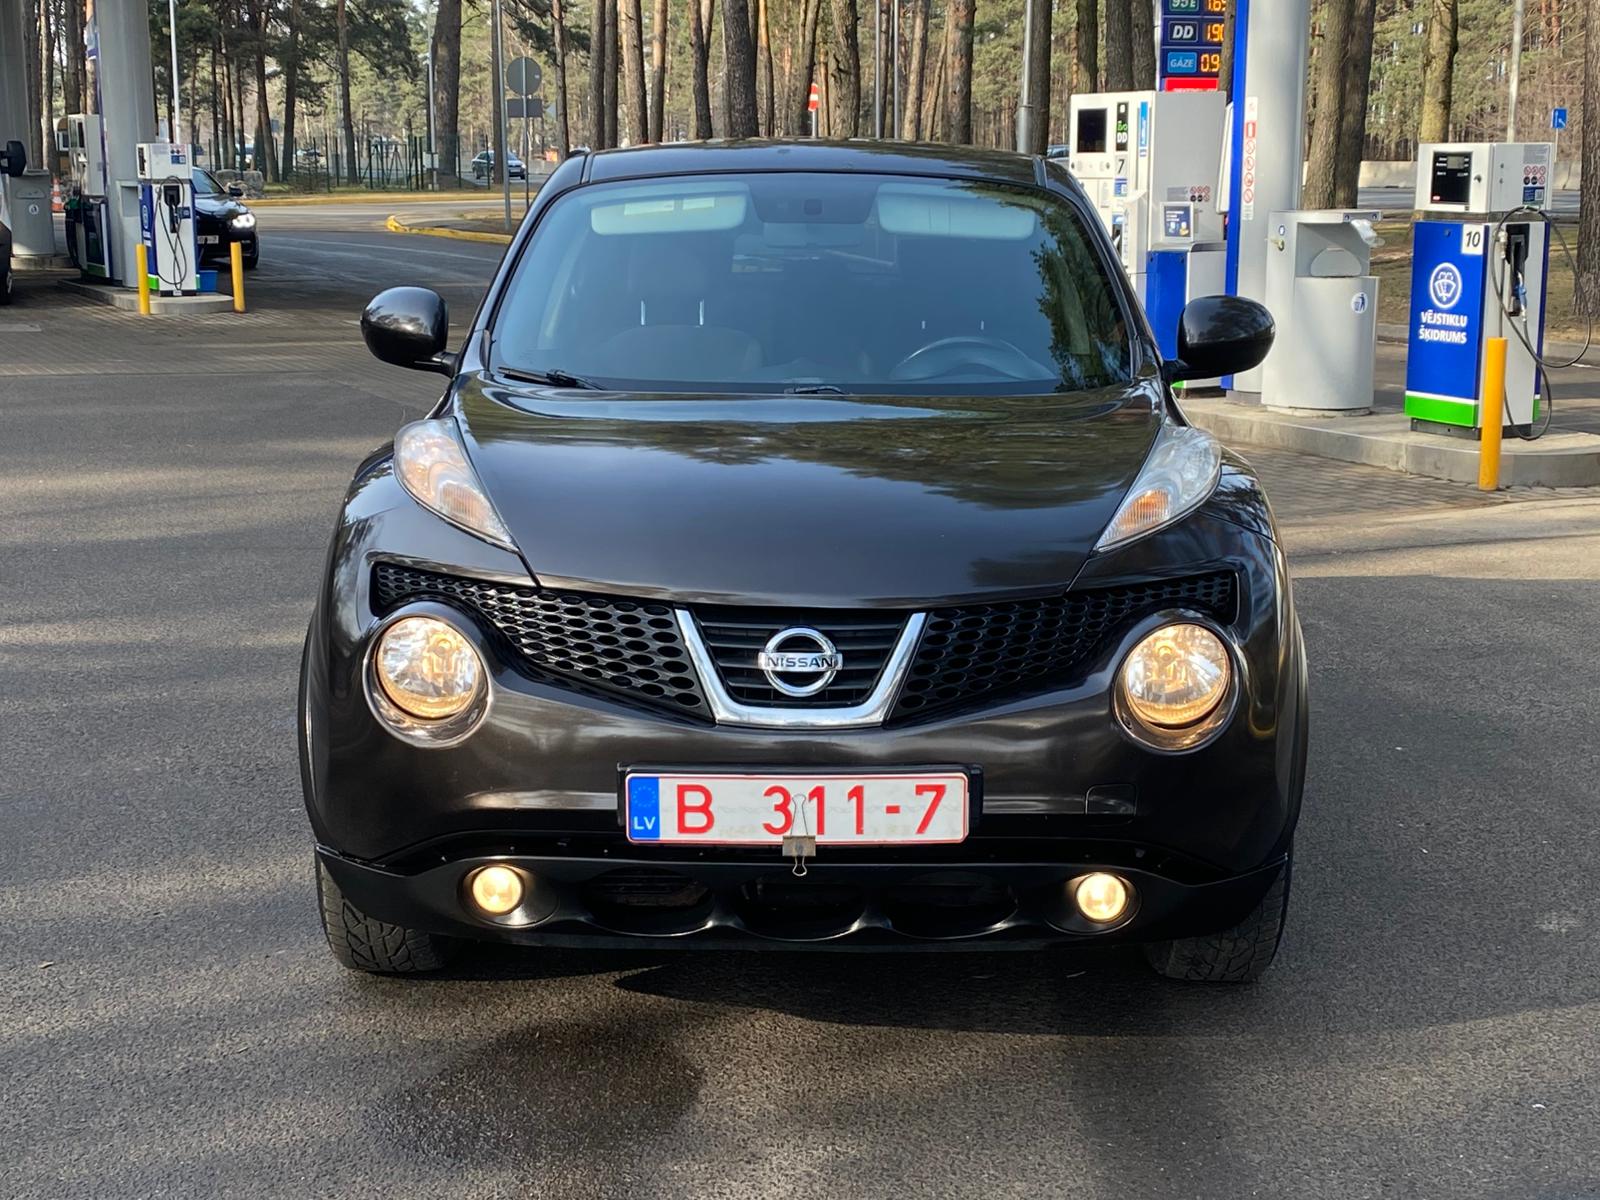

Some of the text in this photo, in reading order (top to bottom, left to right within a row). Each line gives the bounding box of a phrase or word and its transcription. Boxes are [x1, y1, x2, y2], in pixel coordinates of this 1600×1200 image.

[1172, 25, 1194, 39] DD
[1118, 159, 1125, 174] 7
[1466, 231, 1480, 247] 10
[1420, 309, 1468, 327] VĒJSTIKLU
[1418, 325, 1468, 344] ŠĶIDRUMS
[767, 655, 835, 669] NISSAN
[676, 784, 715, 834] B
[633, 816, 656, 831] LV
